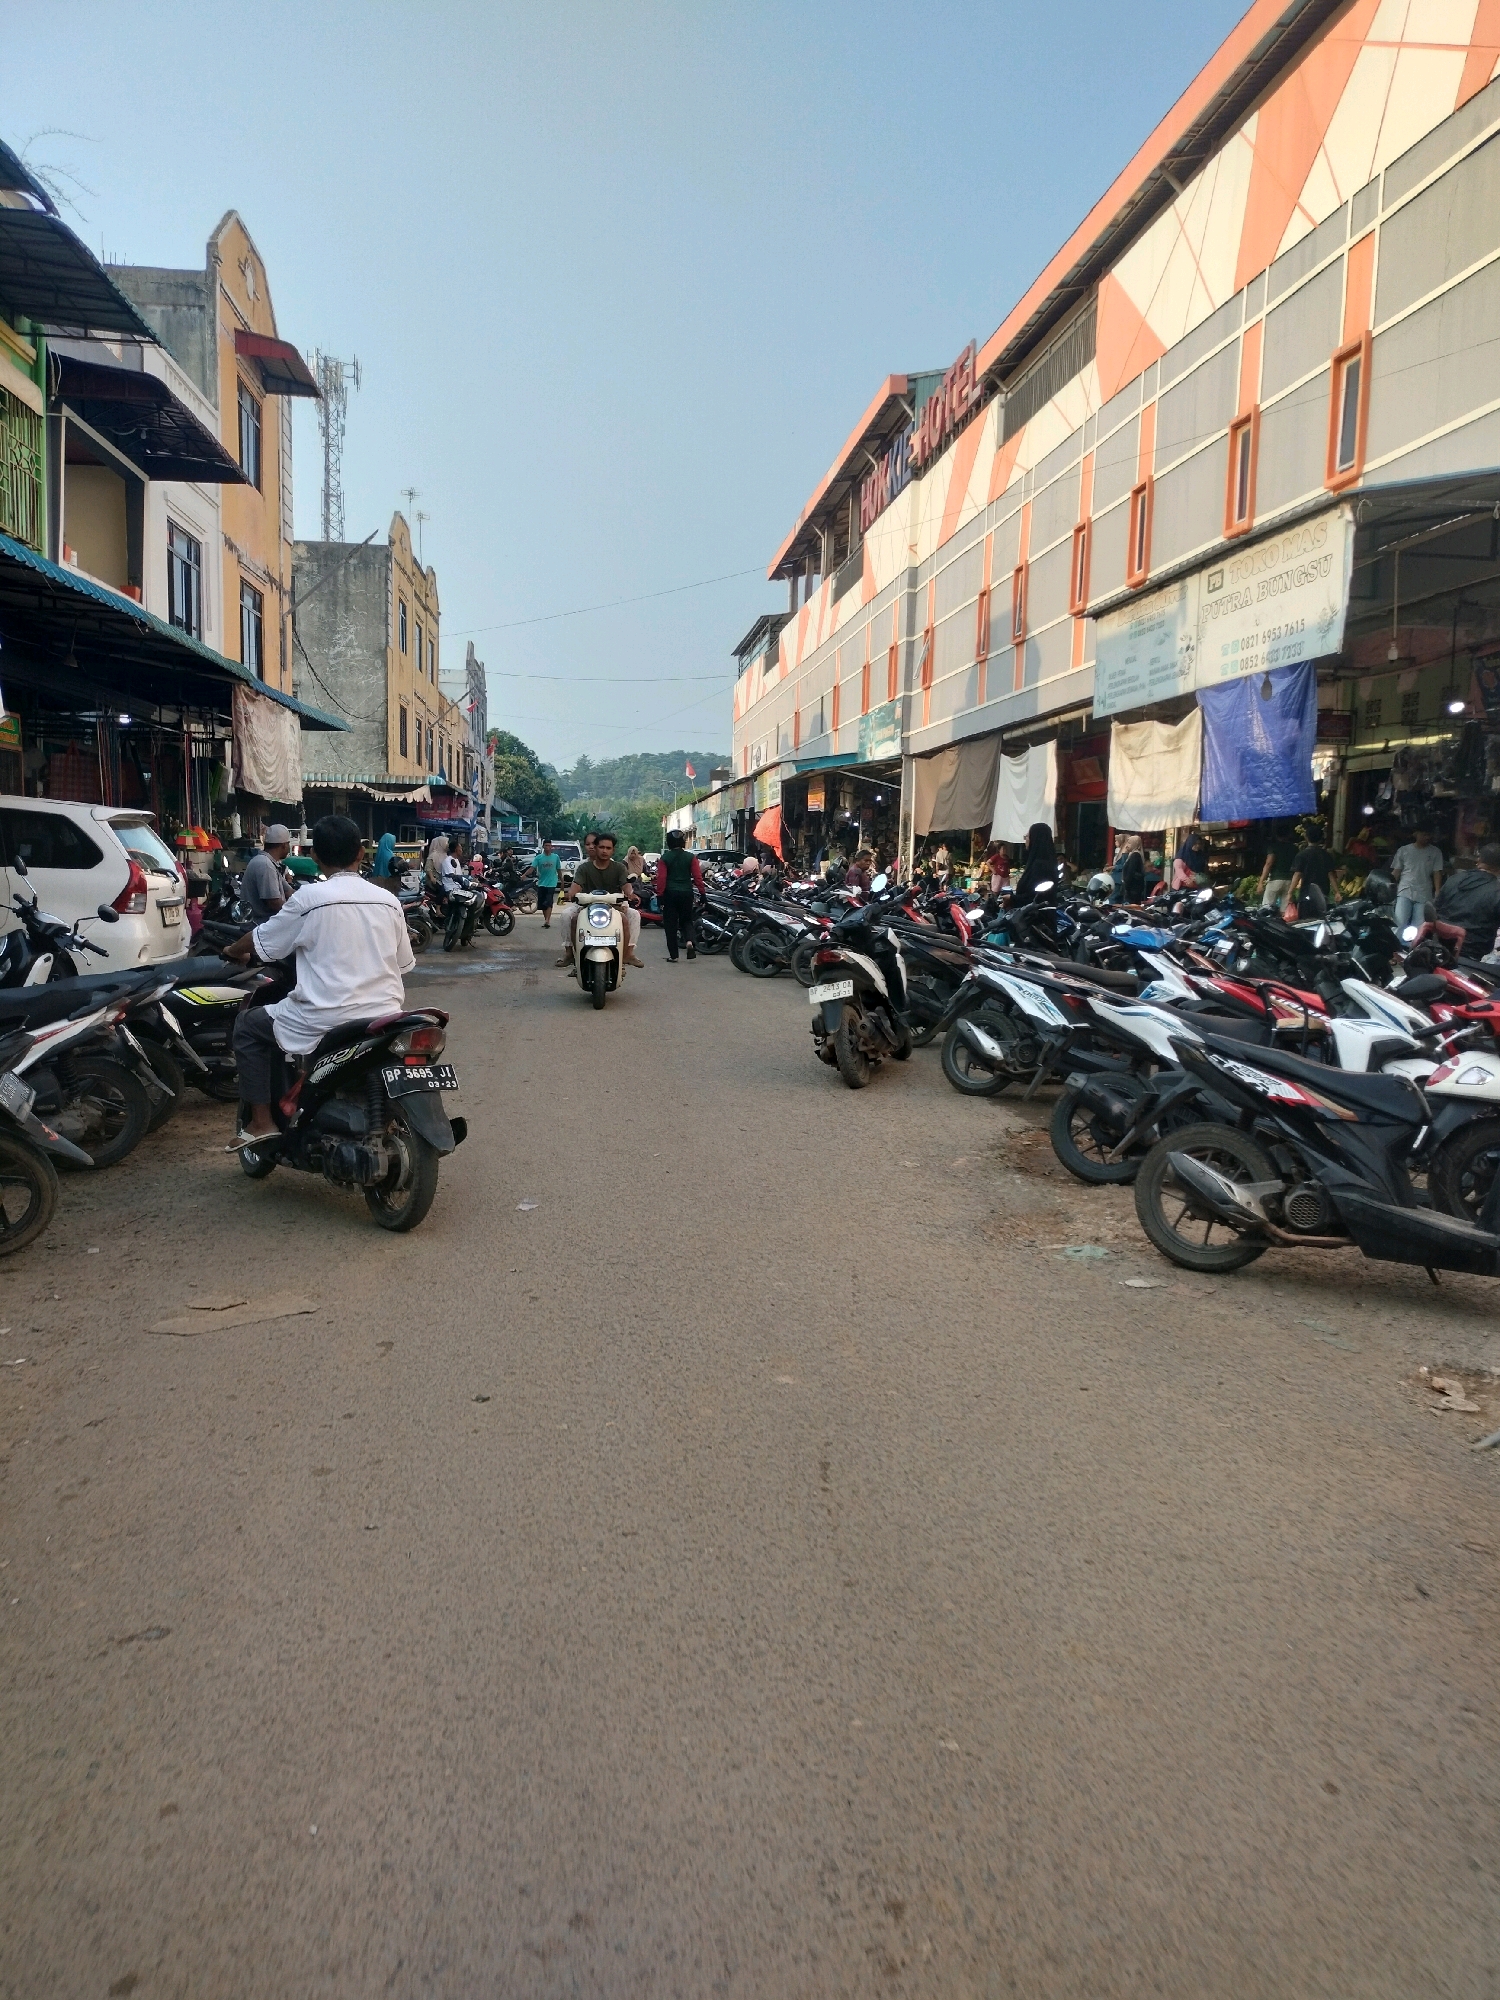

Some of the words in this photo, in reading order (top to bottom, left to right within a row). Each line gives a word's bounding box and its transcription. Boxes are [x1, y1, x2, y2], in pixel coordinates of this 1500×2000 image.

[917, 338, 985, 467] HOTEL
[1229, 544, 1280, 584] TOKO
[1281, 522, 1328, 563] MAS
[1201, 587, 1253, 623] PUTRA
[1256, 554, 1333, 603] BUNGSU
[1209, 573, 1223, 591] PB
[1240, 635, 1259, 651] 0821
[1261, 628, 1282, 645] 6953
[1284, 618, 1305, 636] 7615
[1239, 654, 1259, 671] 0852
[386, 1067, 401, 1082] BP
[406, 1067, 433, 1079] 5695
[440, 1067, 452, 1078] JI
